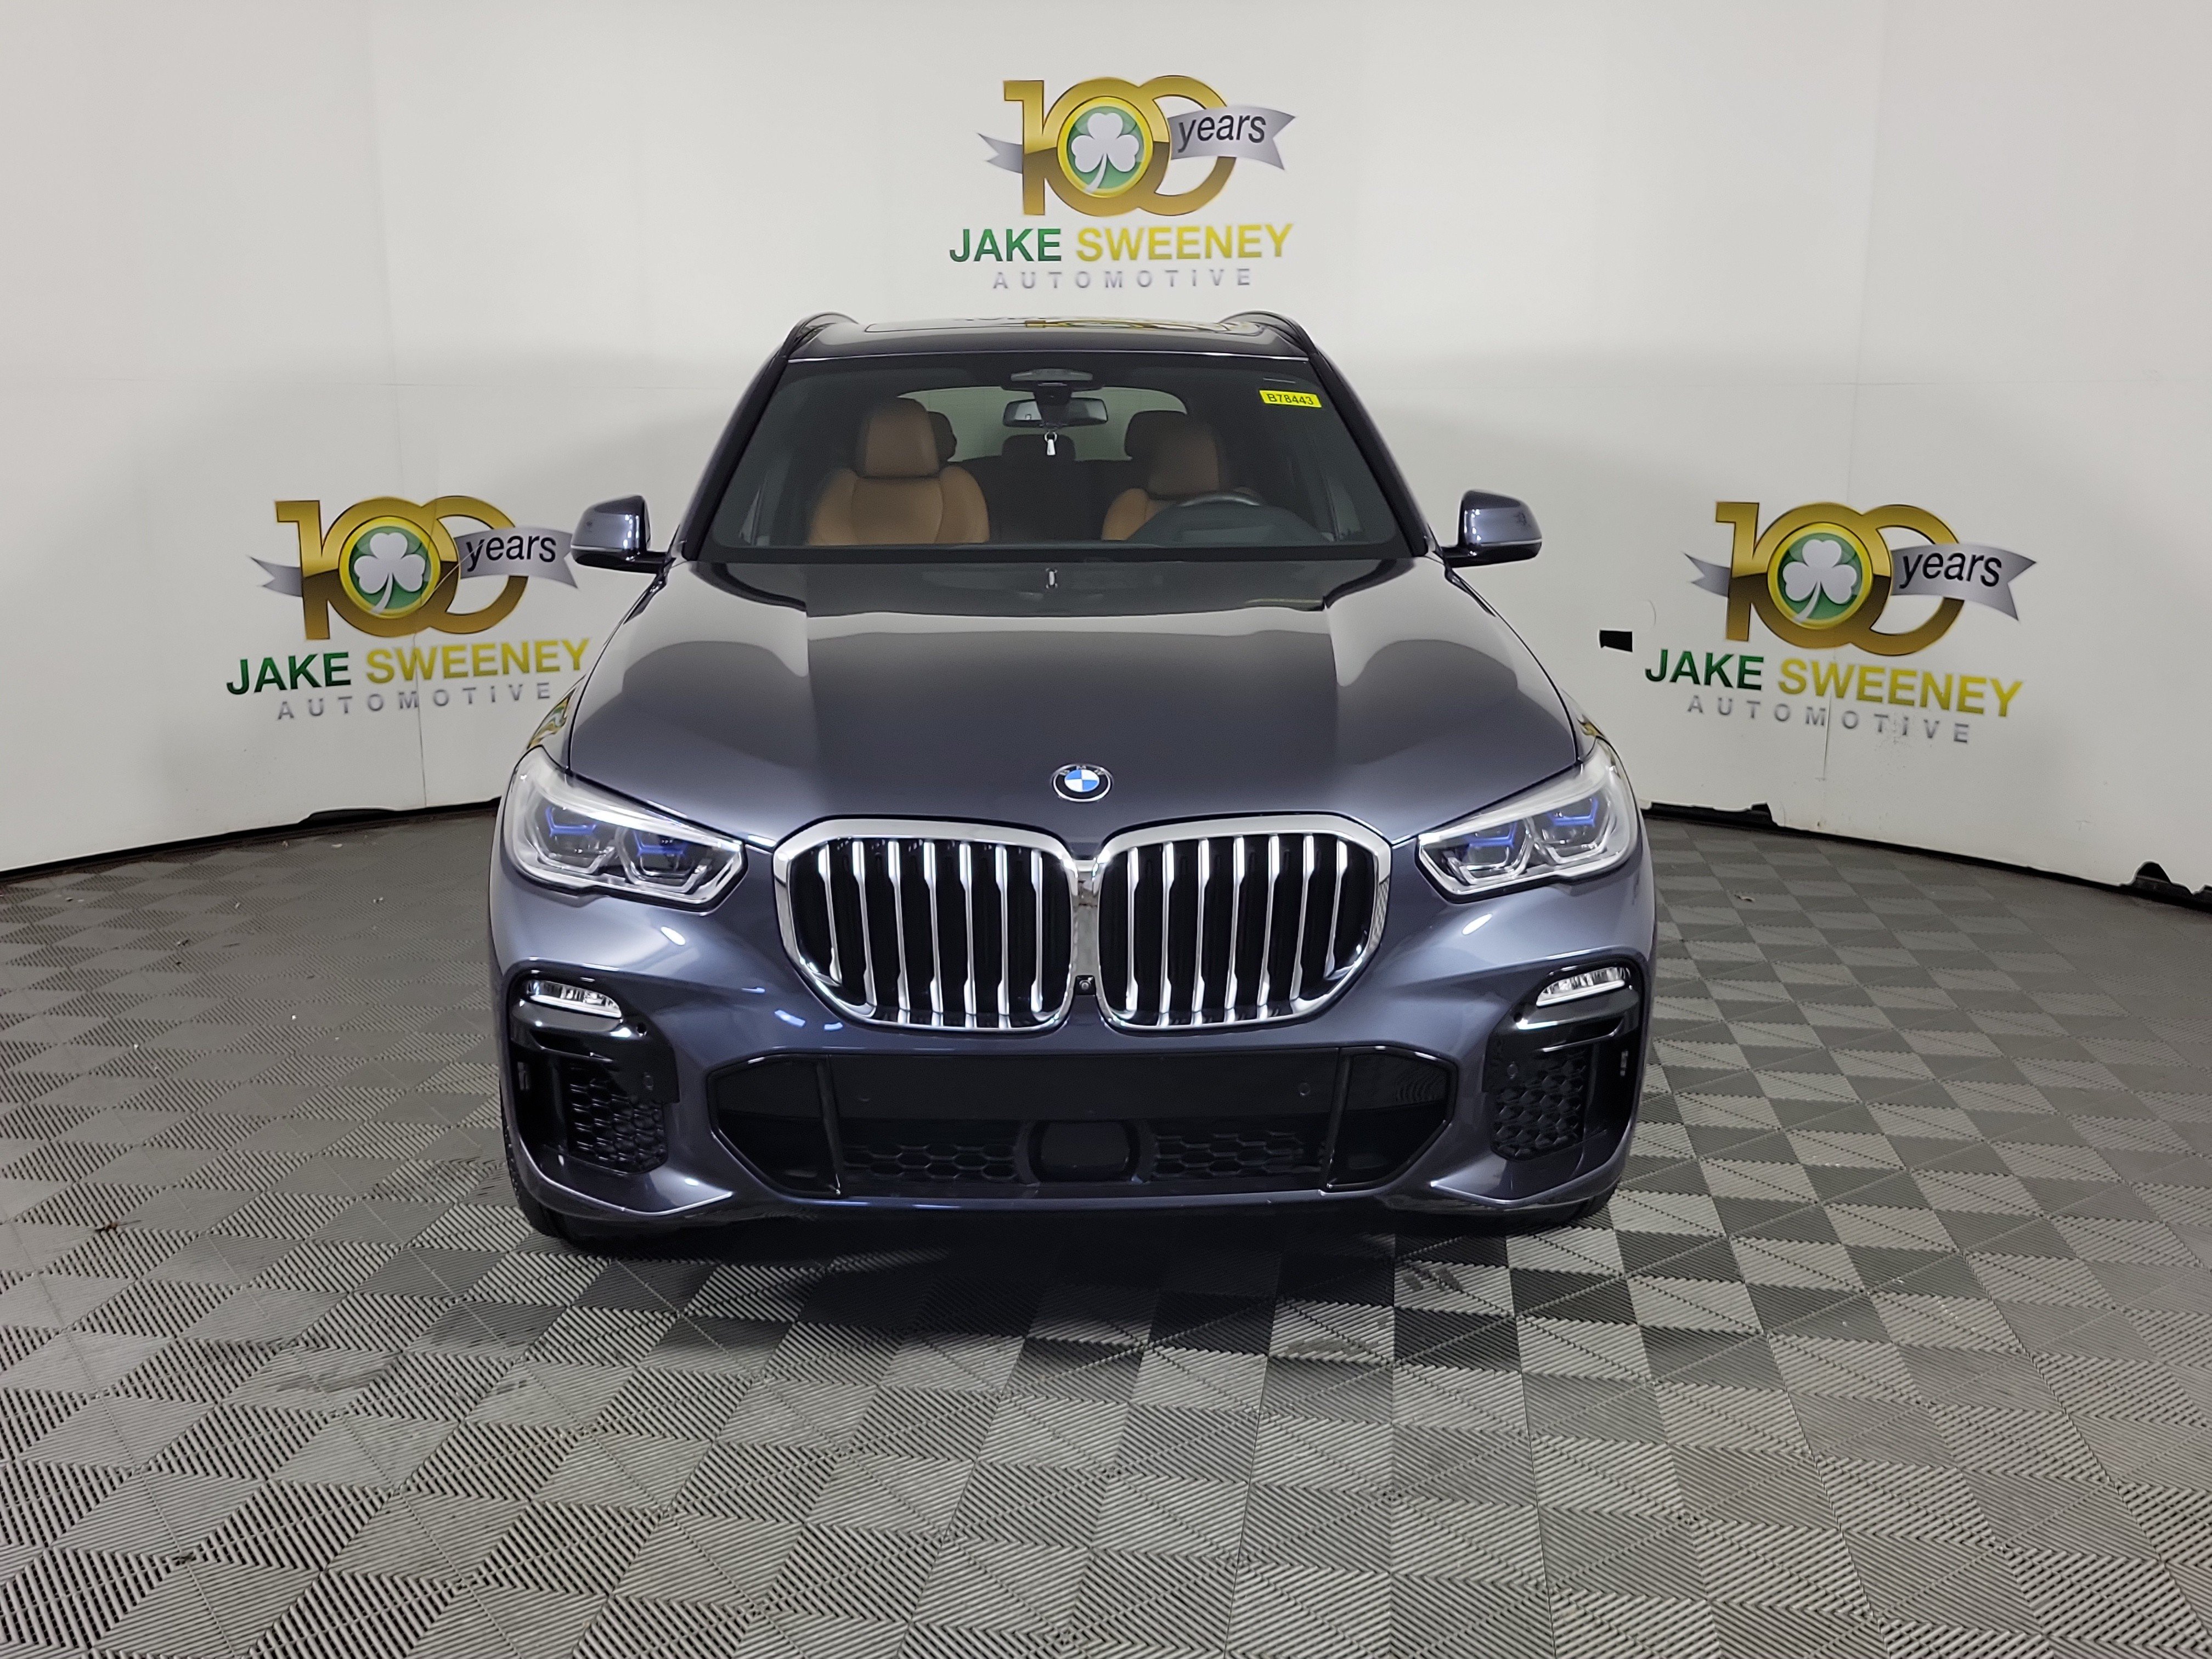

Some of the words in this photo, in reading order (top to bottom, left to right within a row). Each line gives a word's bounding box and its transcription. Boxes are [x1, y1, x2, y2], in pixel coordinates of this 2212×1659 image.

[1003, 75, 1237, 217] 100
[1178, 114, 1266, 153] years
[949, 228, 1062, 262] JAKE
[1075, 223, 1294, 263] SWEENEY
[992, 268, 1251, 290] AUTOMOTIVE
[1267, 393, 1314, 405] B78443
[275, 495, 529, 640] 100
[465, 534, 557, 572] years
[1716, 501, 1966, 656] 100
[1898, 551, 2002, 589] years
[226, 651, 352, 695] JAKE
[365, 637, 590, 684] SWEENEY
[1645, 648, 1765, 692] JAKE
[1778, 657, 2024, 718] SWEENEY
[276, 682, 551, 721] AUTOMOTIVE
[1686, 695, 1970, 745] AUTOMOTIVE
